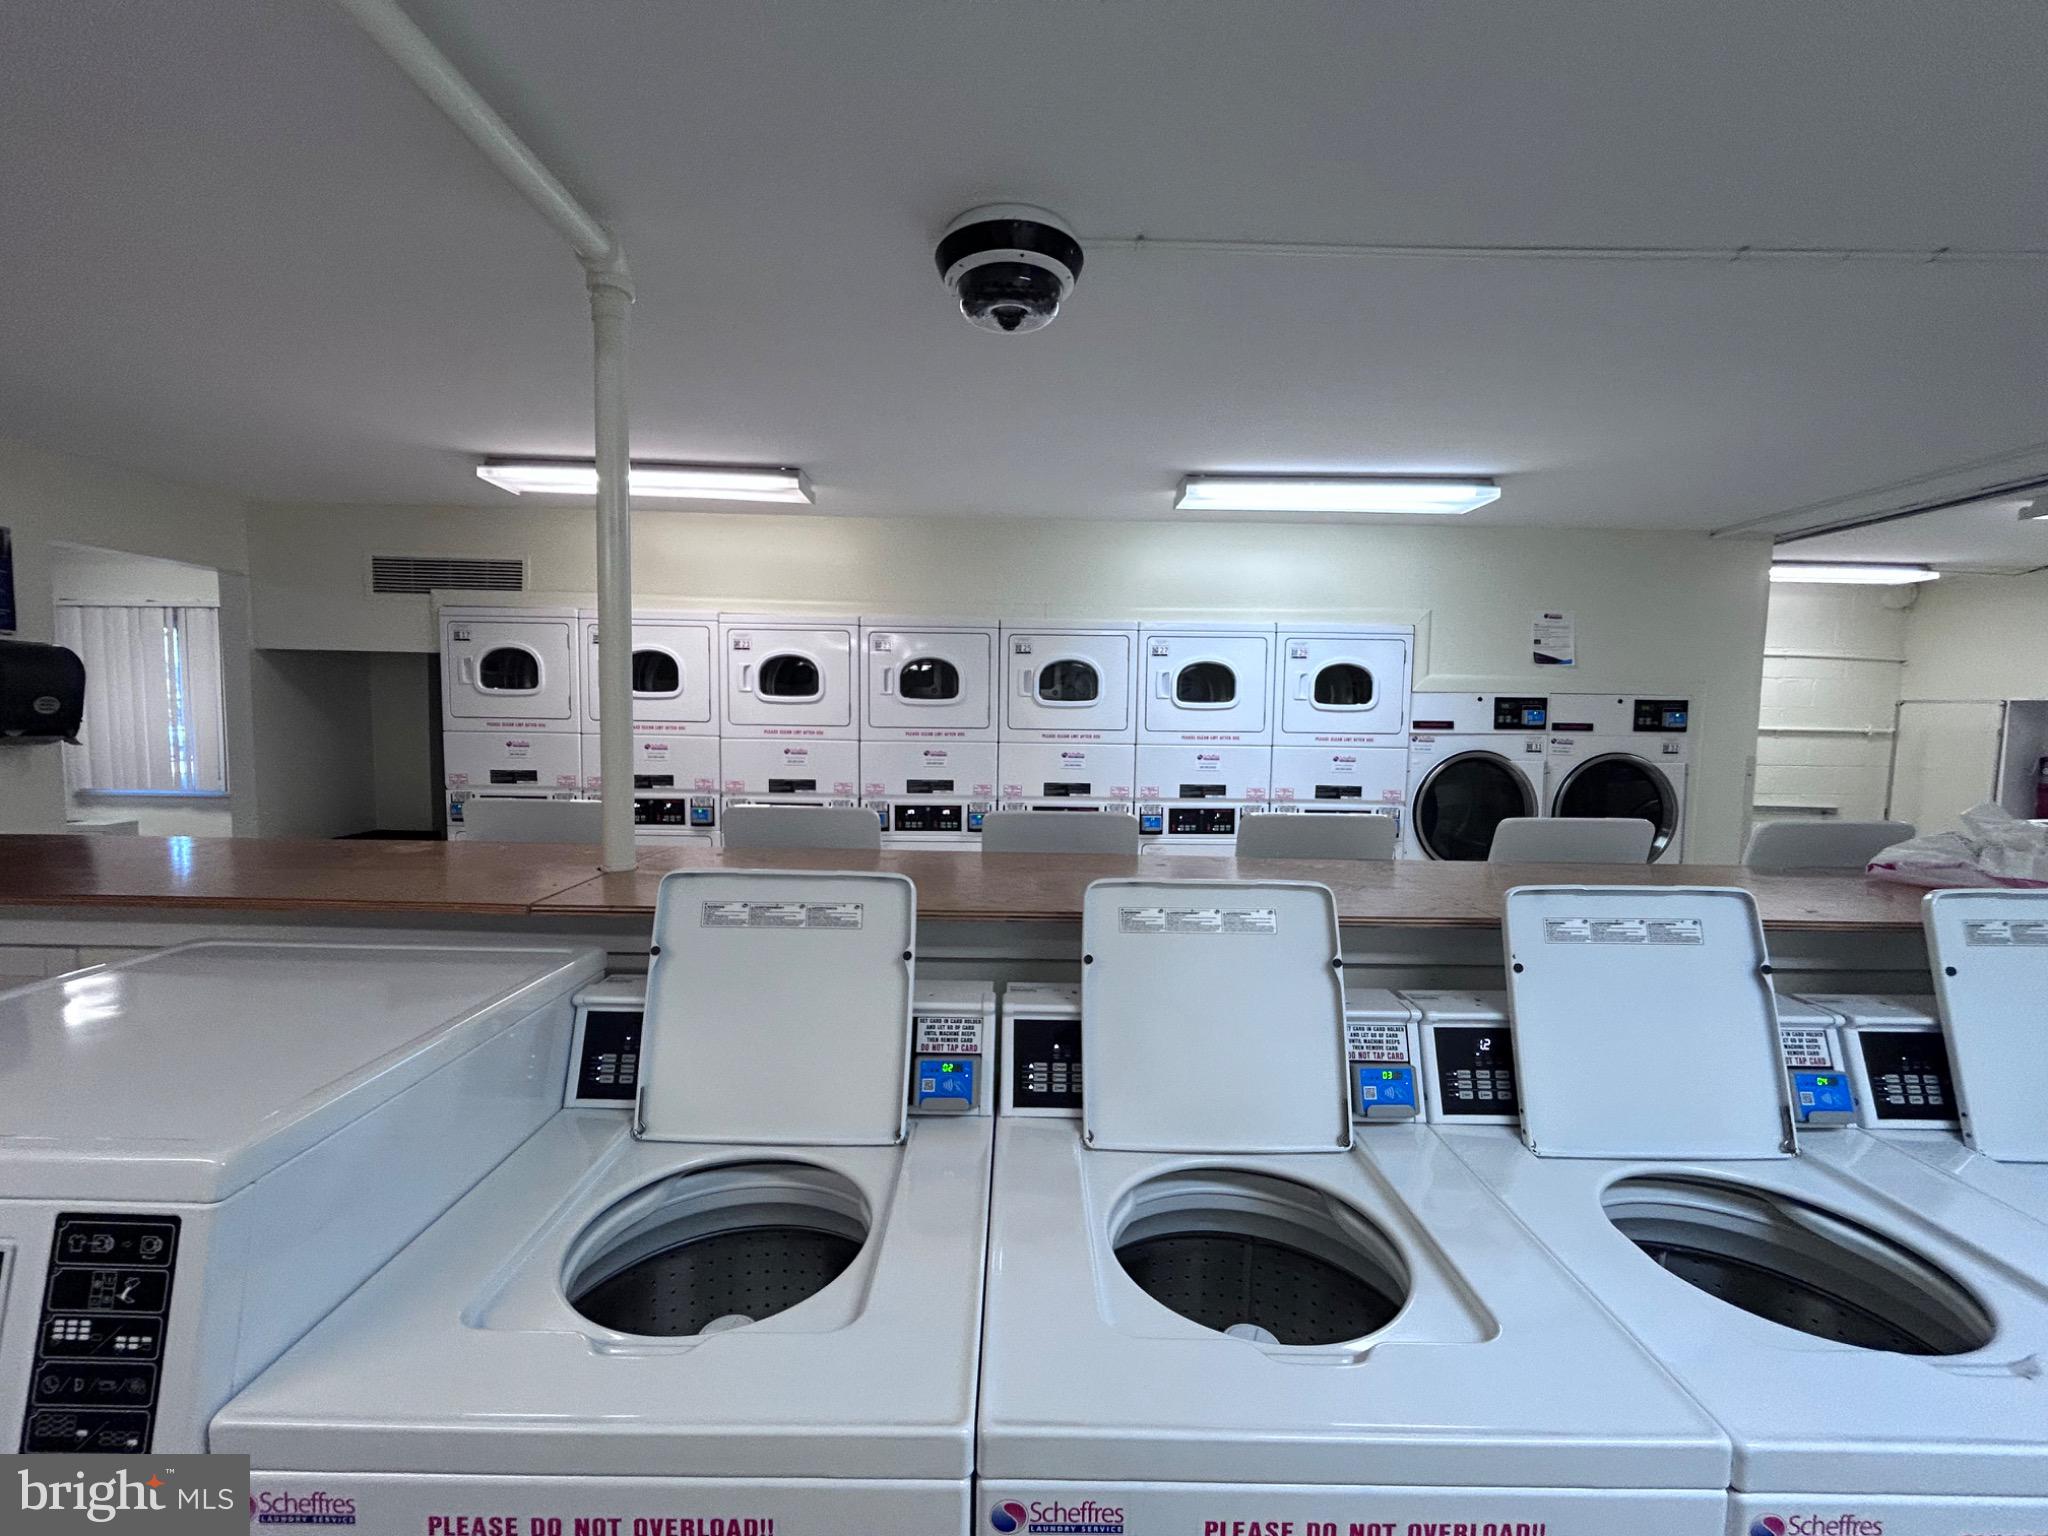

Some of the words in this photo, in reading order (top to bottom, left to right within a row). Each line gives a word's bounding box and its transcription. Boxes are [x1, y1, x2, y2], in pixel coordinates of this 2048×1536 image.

[920, 1043, 930, 1051] DO
[931, 1043, 944, 1051] NOT
[946, 1043, 959, 1052] TAP
[960, 1043, 978, 1052] CARD
[1358, 1051, 1371, 1059] NOT
[1373, 1051, 1385, 1060] TAP
[1387, 1051, 1405, 1060] CARD
[1794, 1057, 1807, 1065] TAP
[1809, 1057, 1826, 1065] CARD
[941, 1063, 954, 1073] 02
[1382, 1071, 1393, 1080] 03
[260, 1491, 356, 1514] Scheffres
[1030, 1501, 1124, 1523] Scheffres
[428, 1516, 519, 1536] PLEASE
[531, 1517, 562, 1536] DO
[574, 1517, 623, 1536] NOT
[633, 1518, 774, 1536] OVERLOAD!!
[1030, 1525, 1077, 1533] LAUNDRY
[1350, 1523, 1398, 1536] NOT
[1788, 1514, 1883, 1536] Scheffres
